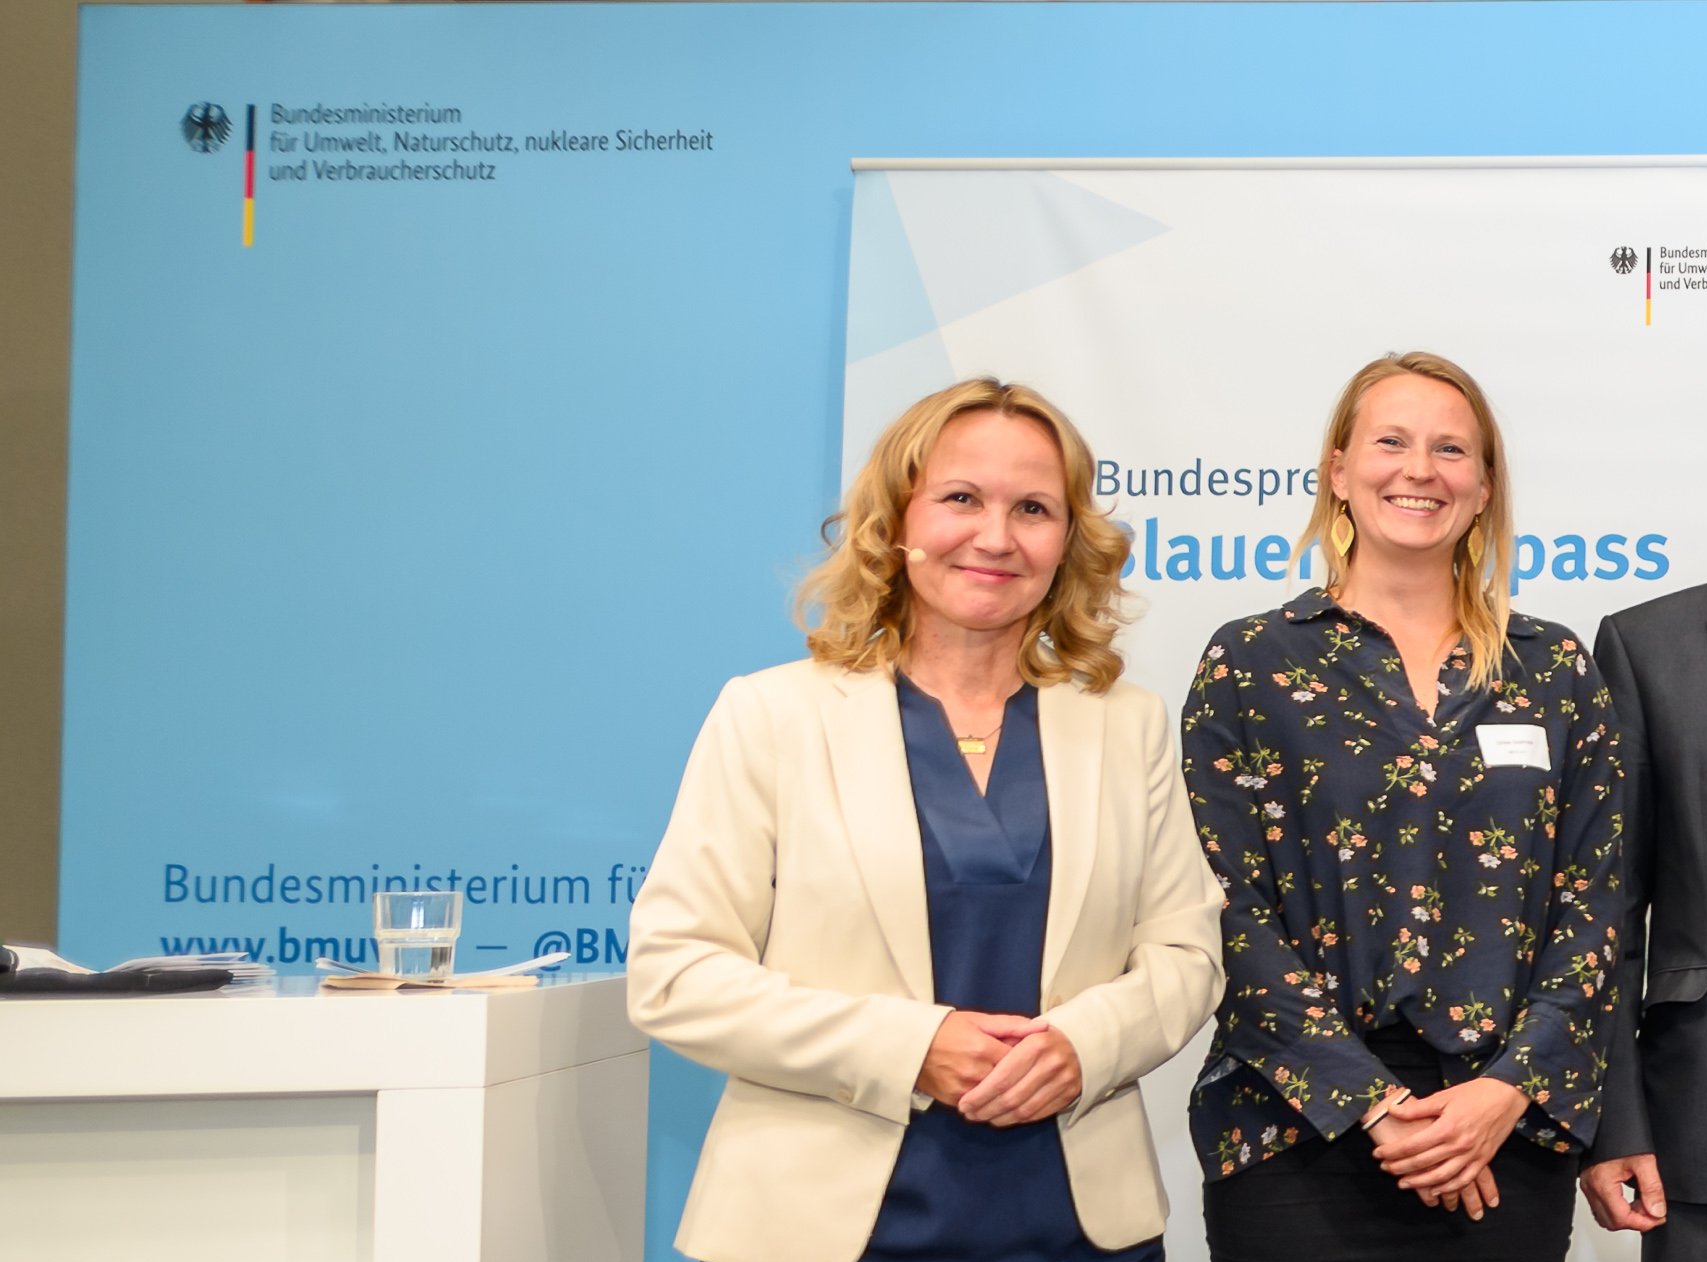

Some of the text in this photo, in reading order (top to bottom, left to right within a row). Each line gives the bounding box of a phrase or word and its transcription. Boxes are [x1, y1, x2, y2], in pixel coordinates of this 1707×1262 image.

[270, 102, 462, 125] Bundesministerium
[269, 129, 714, 154] für Umwelt, Naturschutz, nukleare Sicherheit
[269, 160, 497, 181] und Verbraucherschutz
[1659, 261, 1676, 275] für
[1659, 277, 1680, 290] und
[1096, 457, 1319, 506] Bundespre
[1509, 533, 1670, 597] pass
[162, 863, 650, 904] Bundesministerium fü
[533, 927, 630, 971] @BM
